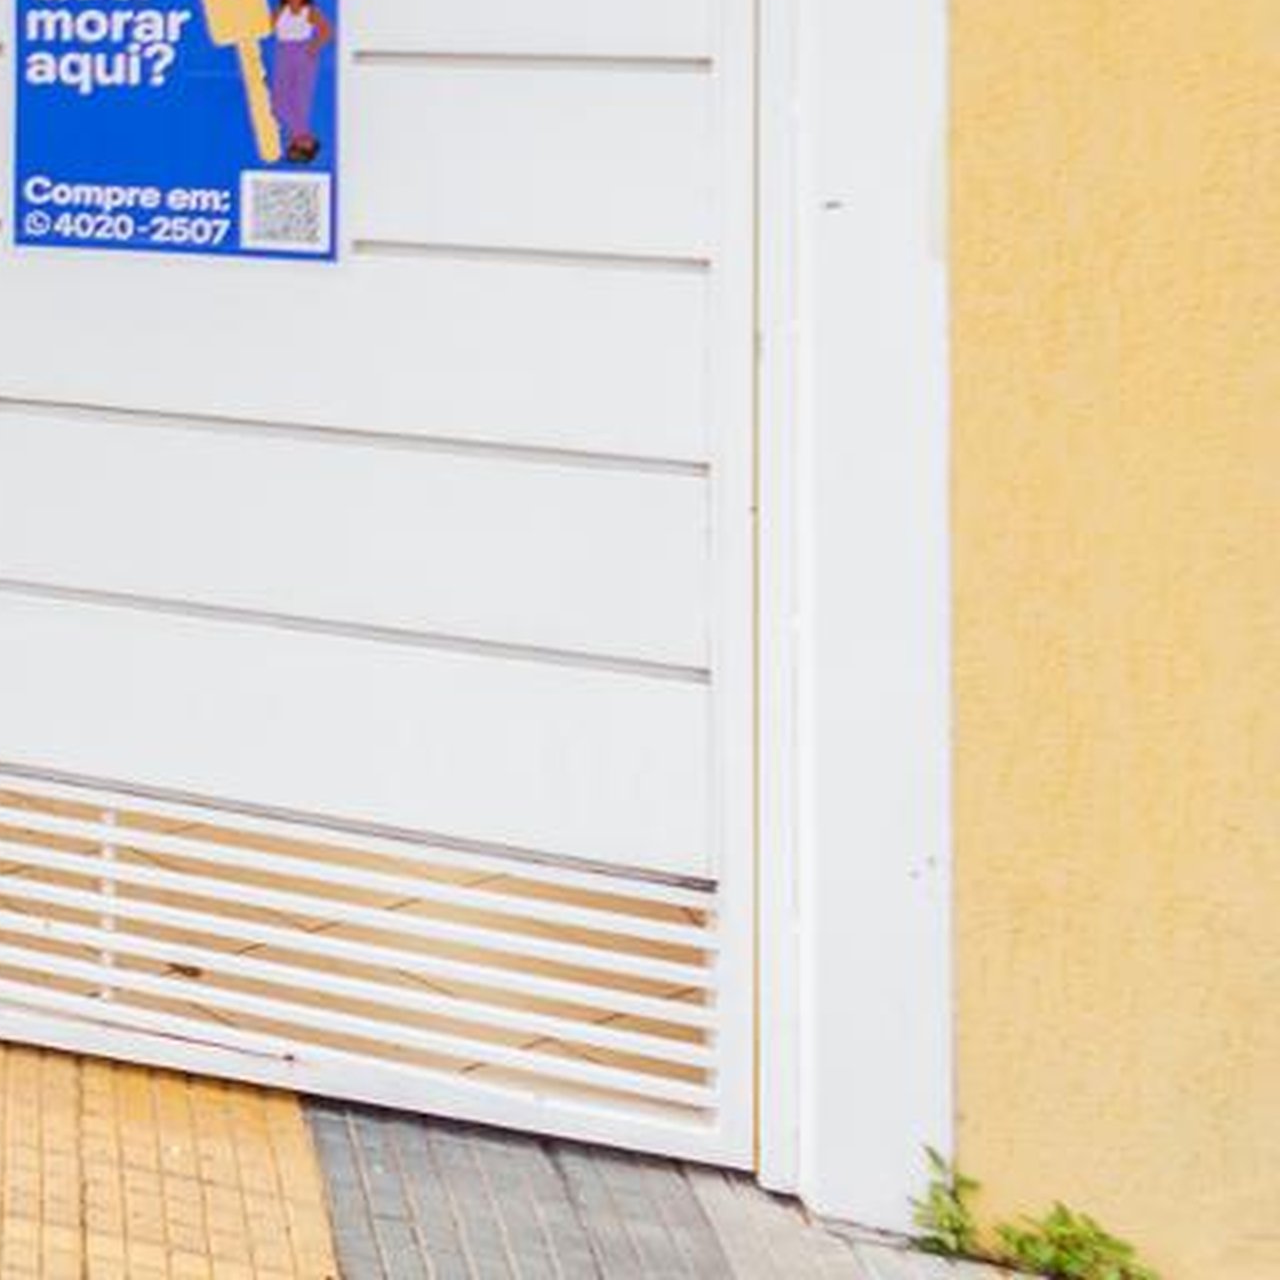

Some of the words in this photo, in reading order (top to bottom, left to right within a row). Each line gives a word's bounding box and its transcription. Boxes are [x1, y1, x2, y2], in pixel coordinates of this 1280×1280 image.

[25, 8, 192, 42] morar
[25, 43, 175, 95] aqui?
[24, 175, 162, 212] Compre
[166, 187, 231, 212] em:
[53, 211, 231, 245] 4020-2507
